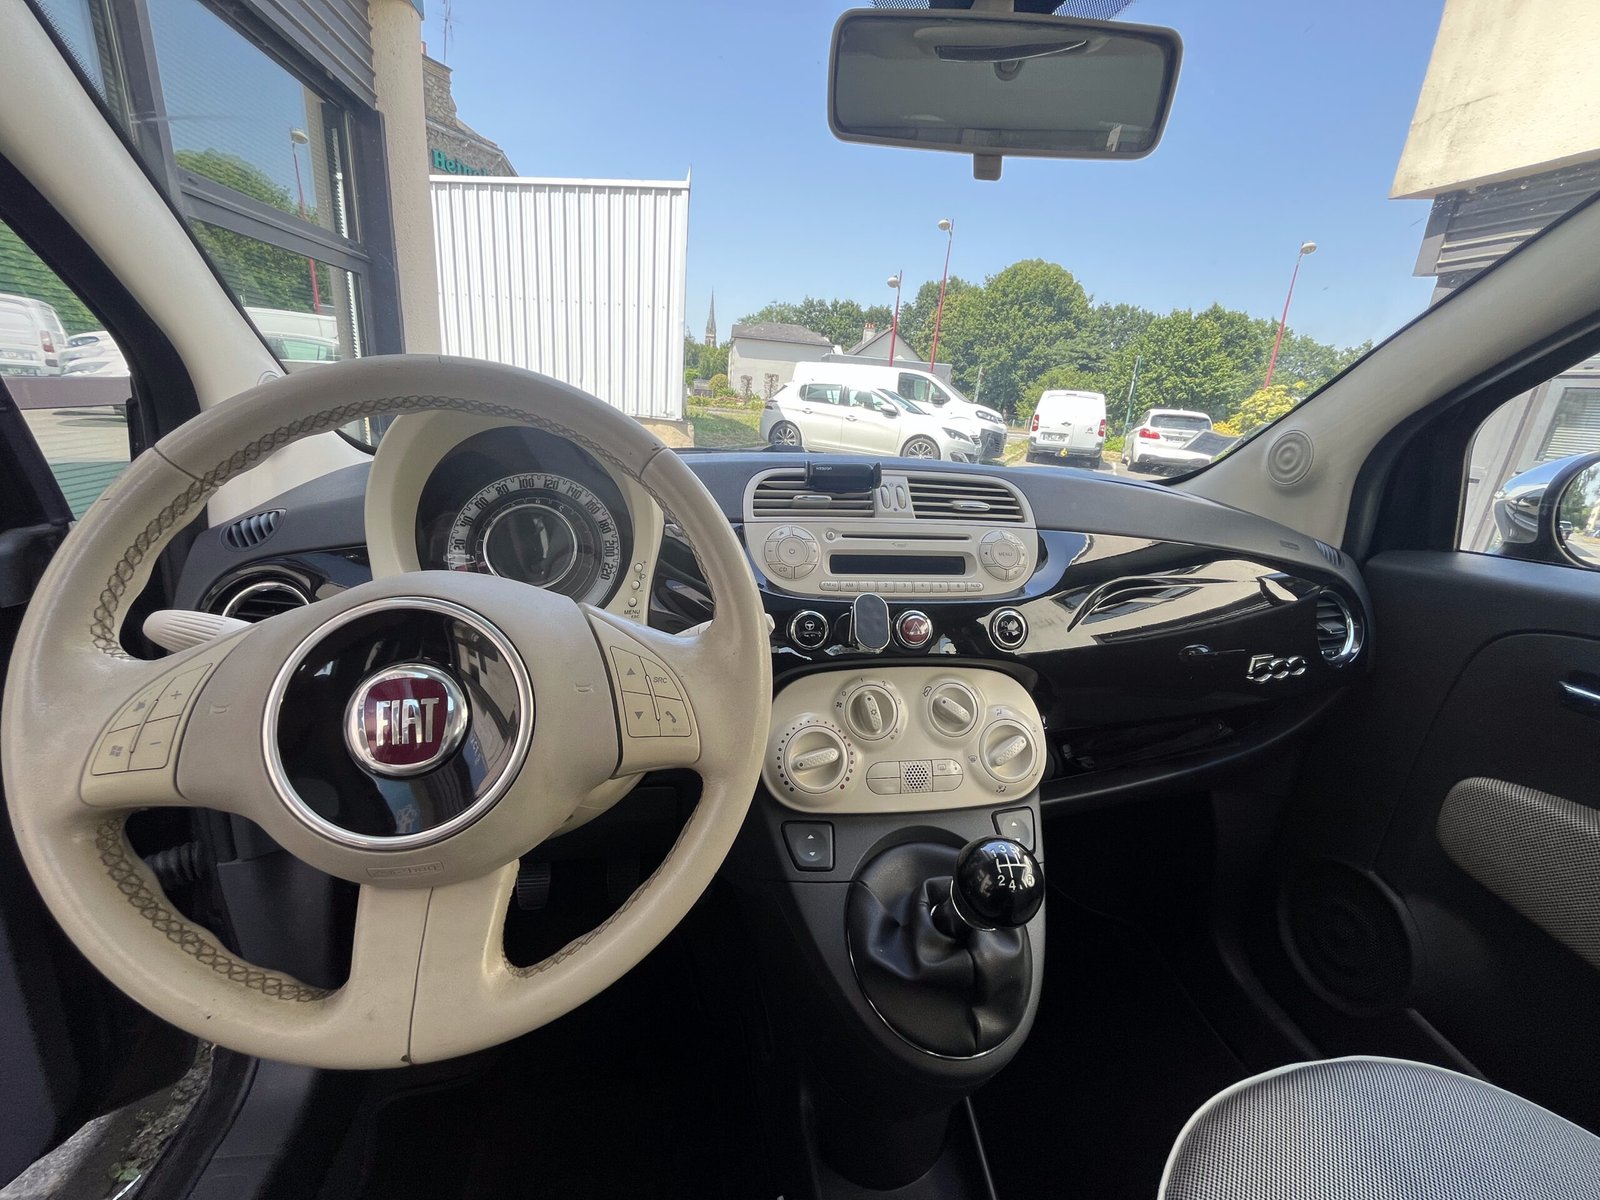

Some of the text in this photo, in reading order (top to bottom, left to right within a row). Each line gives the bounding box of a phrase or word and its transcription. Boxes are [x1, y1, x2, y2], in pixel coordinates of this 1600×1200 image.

[454, 478, 615, 580] 20 40 60 80 100 120 140 160 180 200 220
[653, 676, 668, 684] SRC
[1246, 653, 1307, 684] 500
[376, 697, 440, 747] FIAT
[998, 844, 1006, 853] 3
[997, 874, 1006, 886] 2
[1008, 879, 1017, 891] 4
